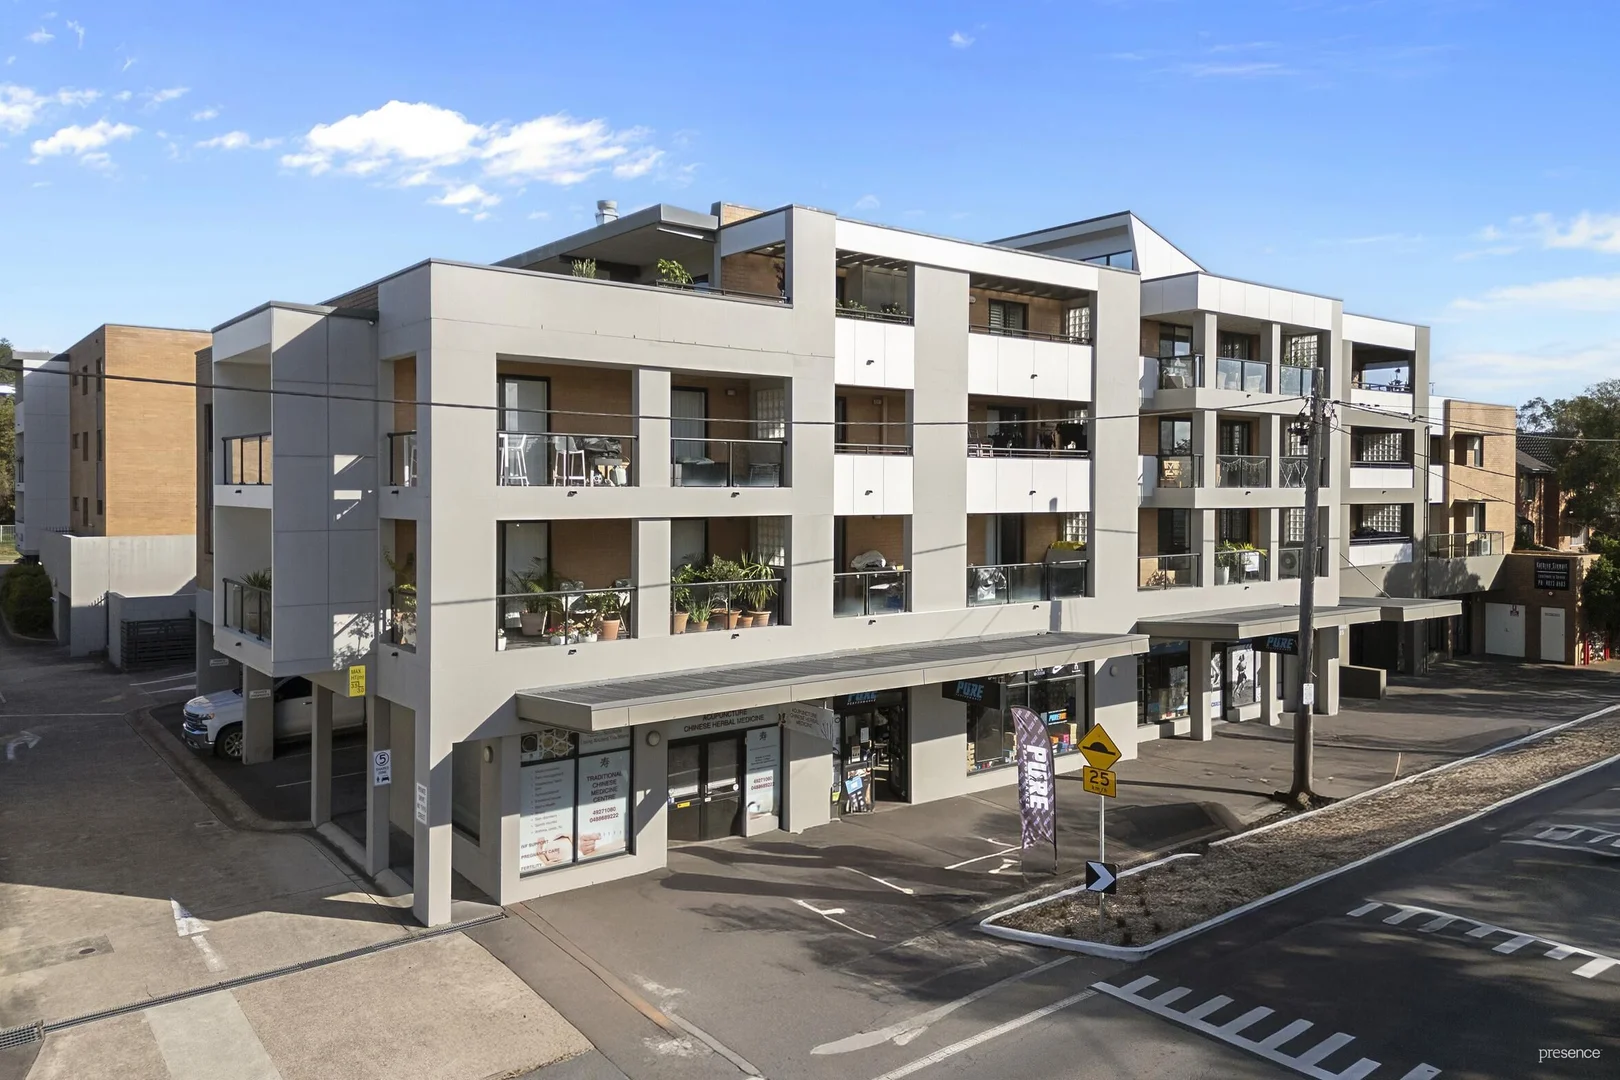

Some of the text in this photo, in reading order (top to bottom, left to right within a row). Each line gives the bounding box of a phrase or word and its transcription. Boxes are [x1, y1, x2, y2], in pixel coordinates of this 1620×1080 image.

[1266, 636, 1293, 649] PURE
[956, 680, 985, 699] PURE
[702, 709, 747, 721] ACUPUNCTURE
[684, 714, 764, 732] CHINESE HERBAL MEDICINE
[379, 754, 387, 765] 5
[586, 771, 622, 782] TRADITIONAL
[1022, 744, 1030, 809] PERFORMANCE
[1026, 745, 1049, 811] PURE
[1089, 770, 1110, 786] 25
[592, 779, 617, 789] CHINESE
[1092, 785, 1108, 793] km/h
[590, 786, 618, 796] MEDICINE
[592, 794, 616, 803] CENTRE
[521, 850, 548, 859] PREGNANCY
[521, 863, 542, 871] FERTILITY
